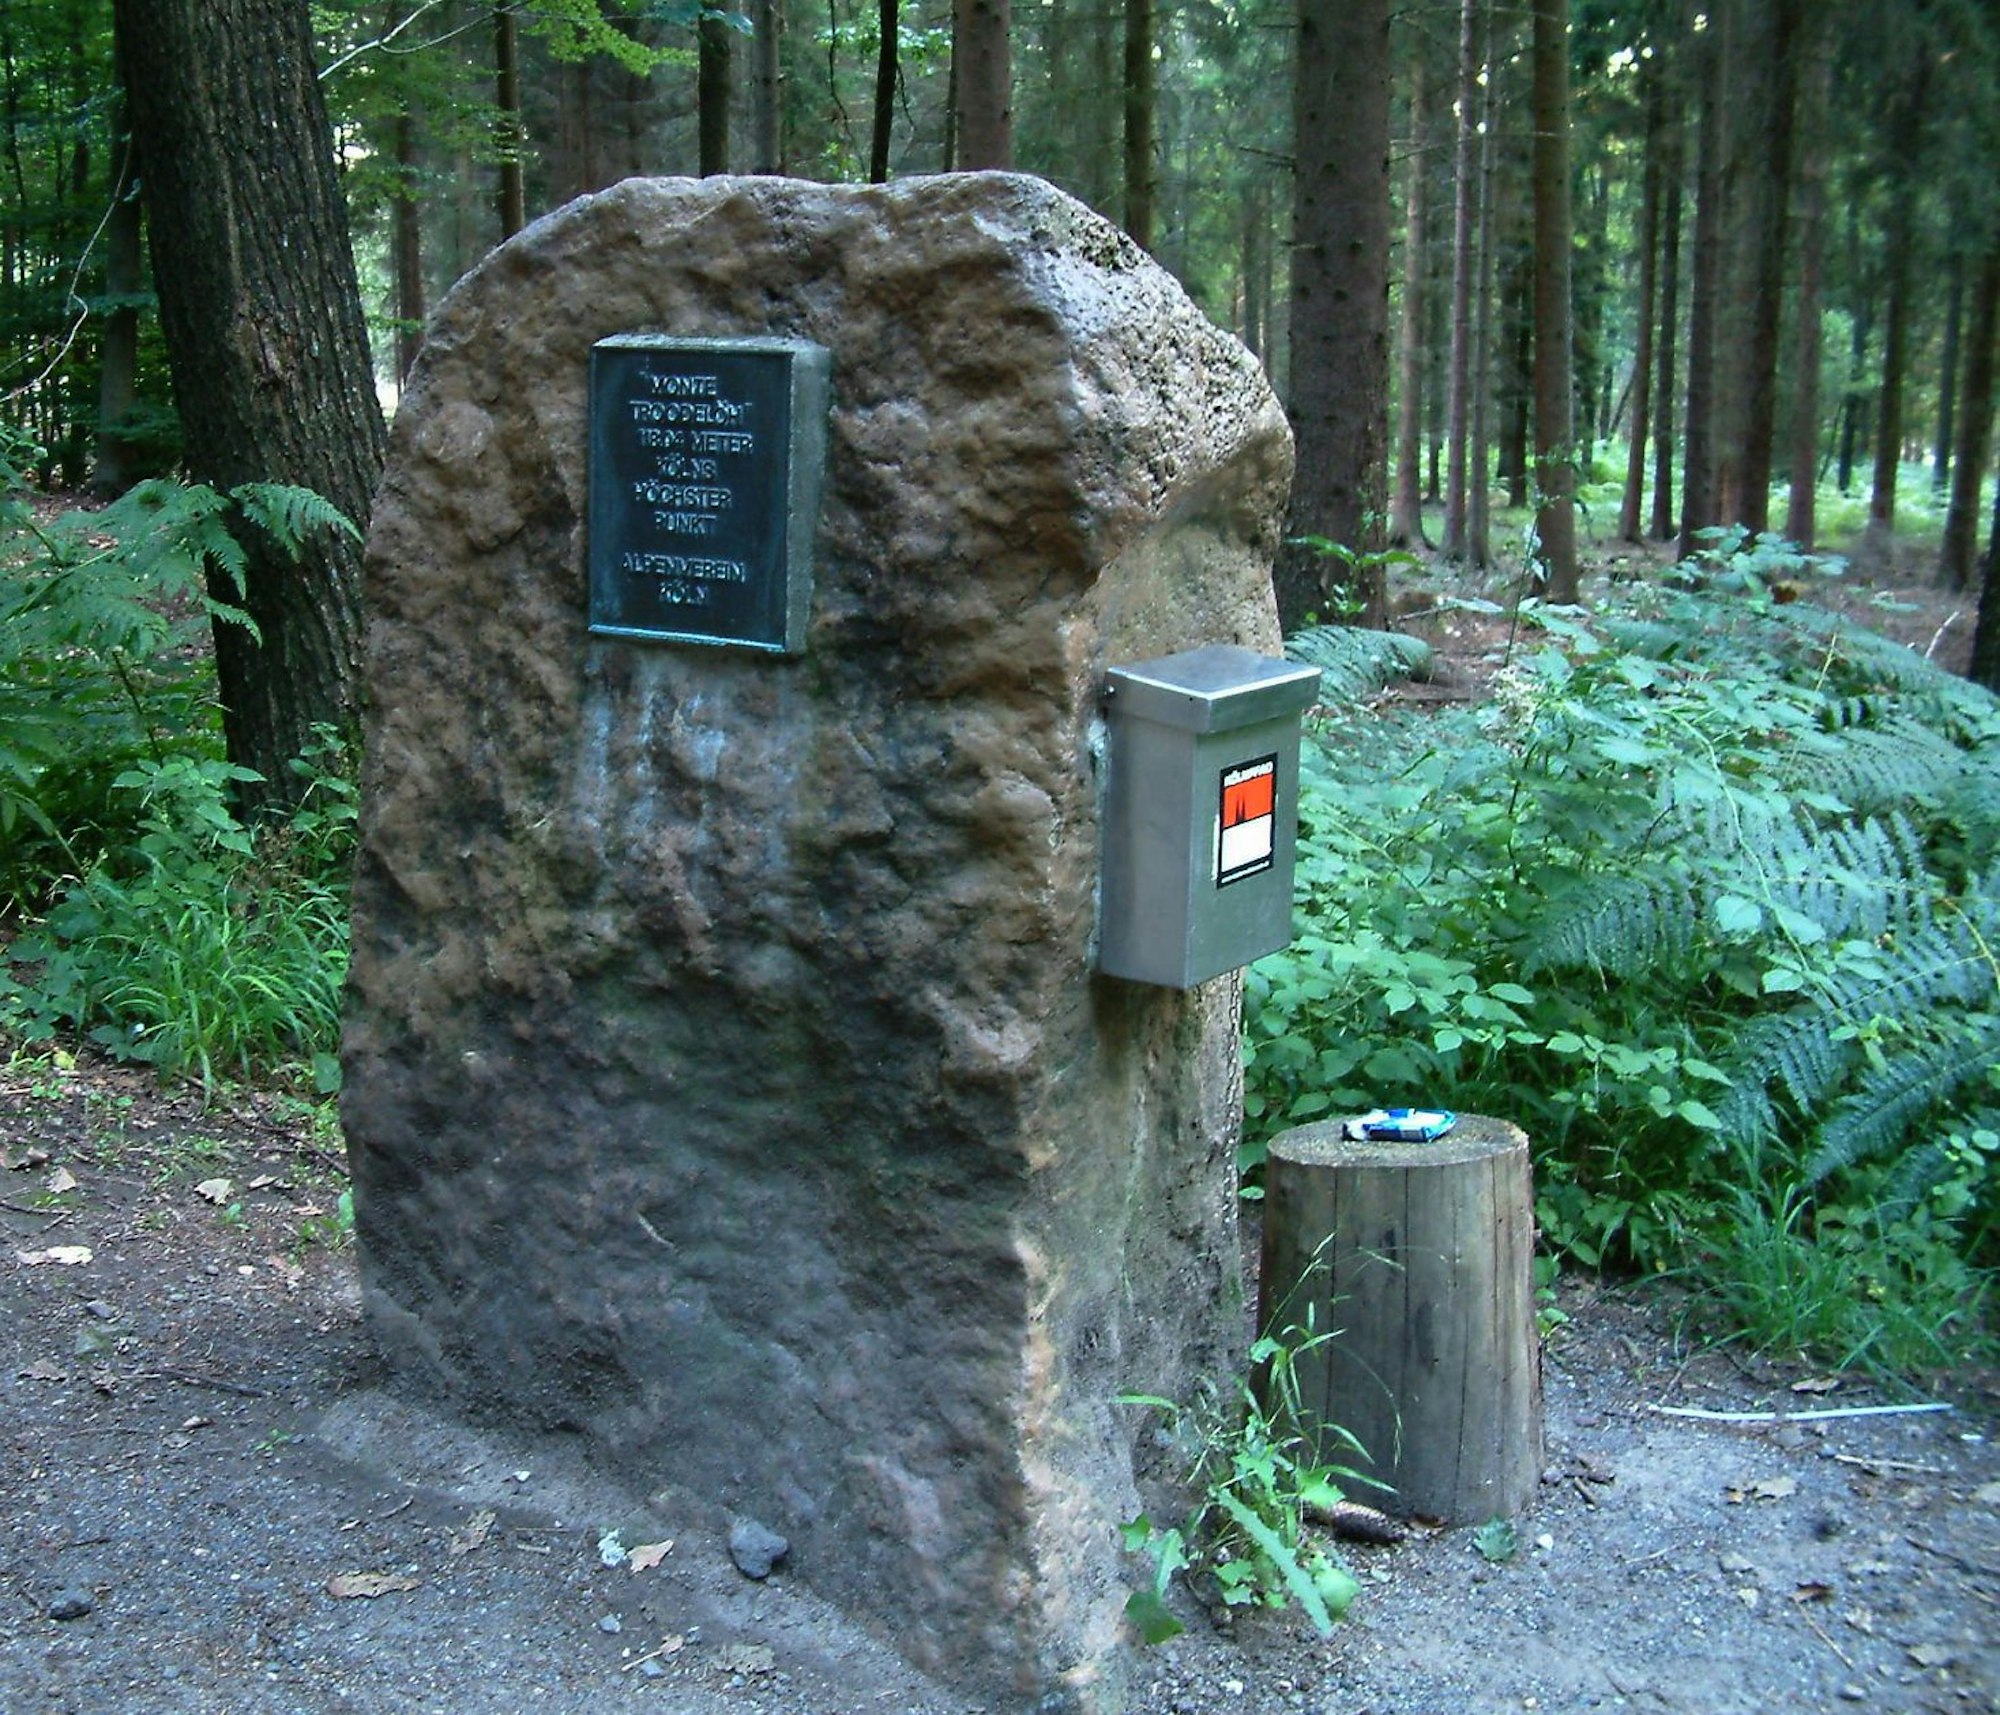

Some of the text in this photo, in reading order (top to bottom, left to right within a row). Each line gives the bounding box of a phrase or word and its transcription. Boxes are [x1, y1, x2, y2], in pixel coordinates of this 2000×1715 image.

[691, 430, 753, 455] METER
[655, 452, 718, 480] KÖLNS
[633, 478, 733, 508] HÖCHSTER
[654, 512, 718, 535] PUNKT
[623, 551, 748, 583] ALPENVEREIN
[658, 579, 711, 605] KÖLN
